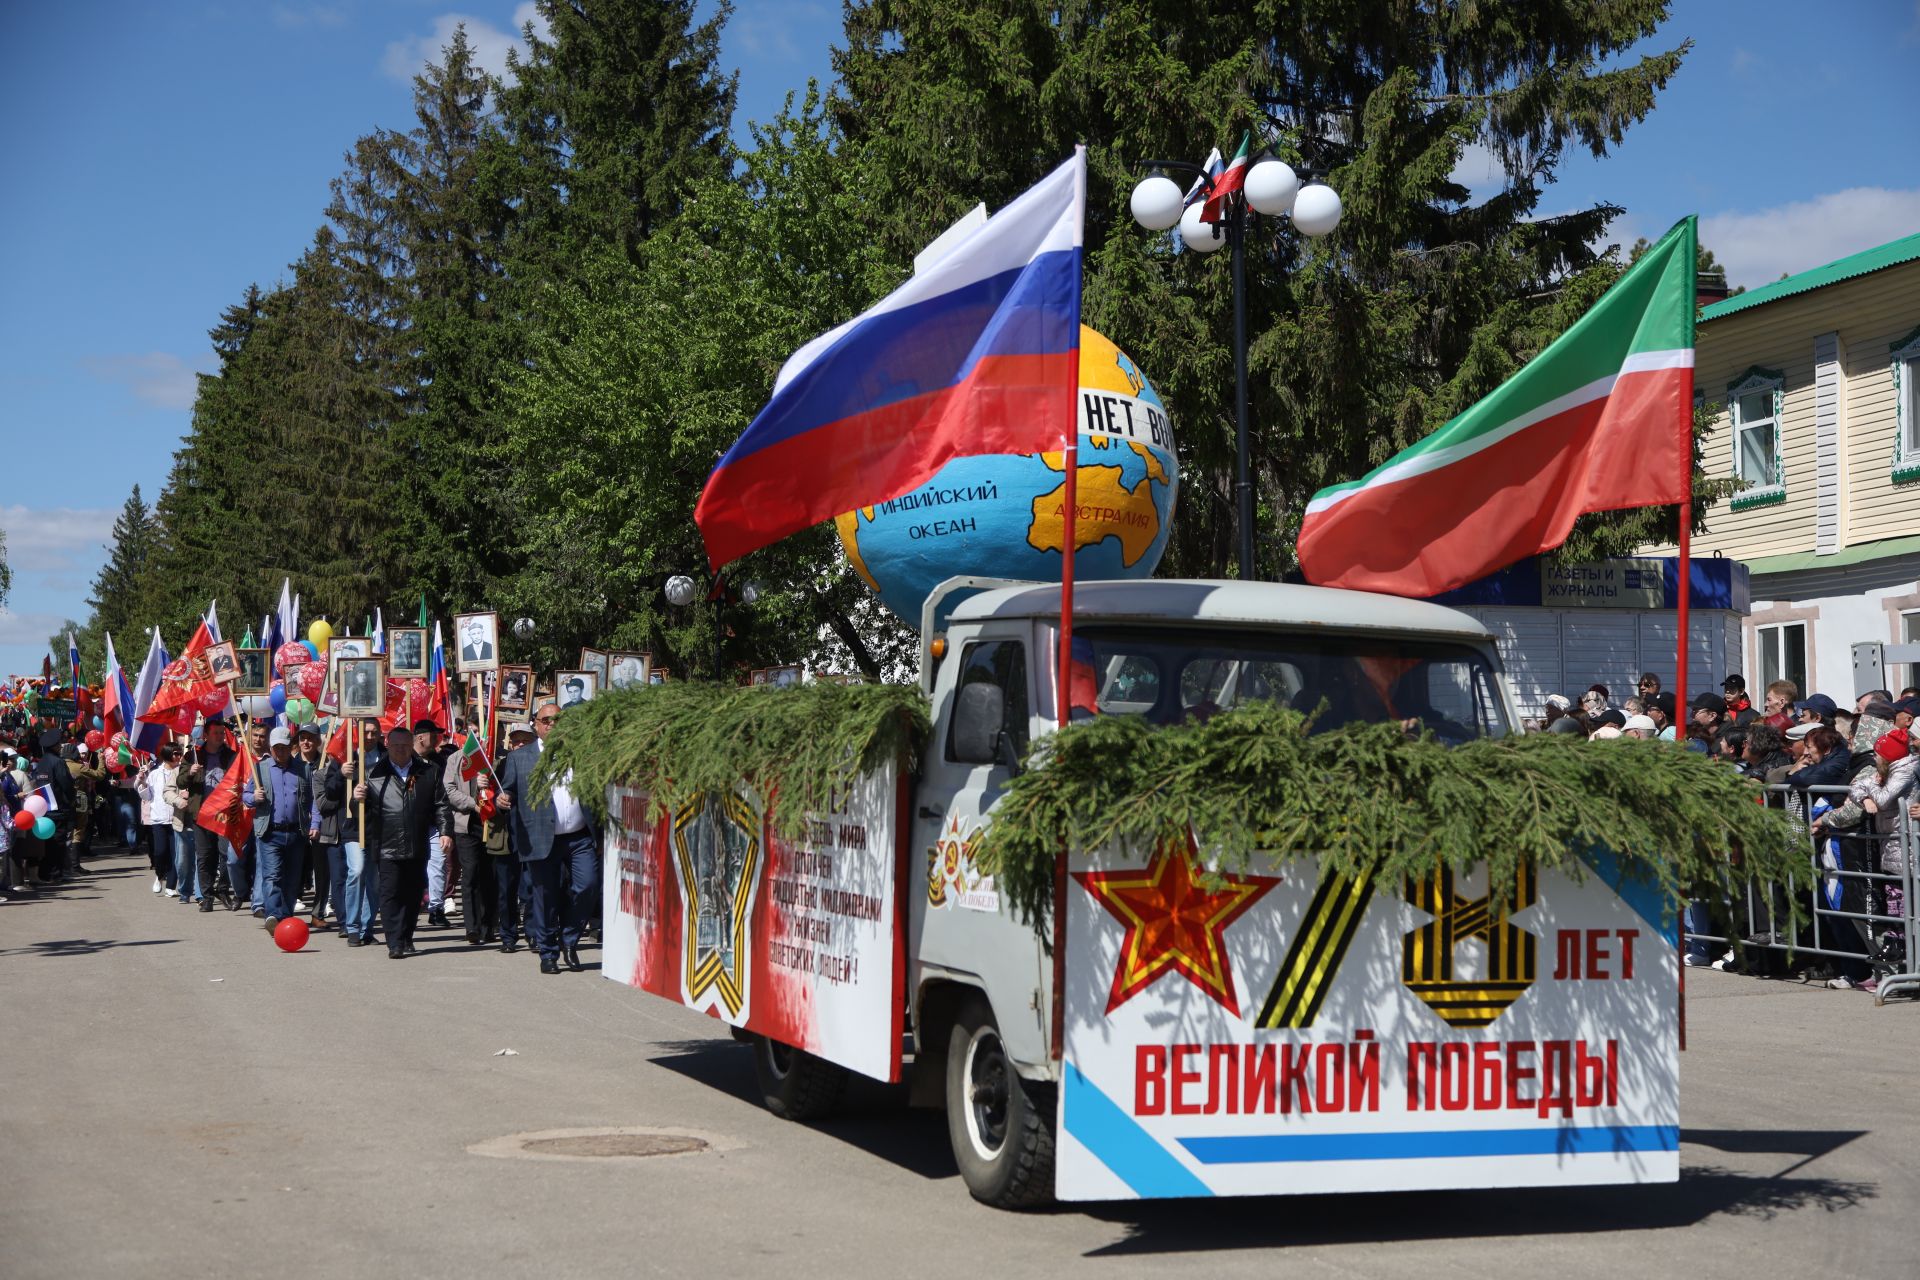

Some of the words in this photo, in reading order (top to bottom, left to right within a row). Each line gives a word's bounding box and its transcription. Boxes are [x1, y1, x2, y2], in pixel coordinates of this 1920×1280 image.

[1083, 393, 1135, 437] НЕТ
[881, 480, 998, 515] ИНДИЙСКИЙ
[909, 517, 977, 541] ОКЕАН
[1547, 567, 1601, 581] ГАЗЕТЫ
[1605, 569, 1614, 581] И
[1547, 584, 1618, 598] ЖУРНАЛЫ
[839, 824, 866, 850] МИРА
[795, 851, 832, 879] ОПЛАЧЕН
[768, 878, 818, 910] ТРИДЦАТЬЮ
[821, 888, 882, 922] МИЛЛИОНАМИ
[794, 915, 831, 945] ЖИЗНЕЙ
[769, 941, 815, 974] СОВЕТСКИХ
[1553, 929, 1640, 980] ЛЕТ
[1134, 1029, 1380, 1116] ВЕЛИКОЙ
[1407, 1039, 1618, 1118] ПОБЕДЫ
